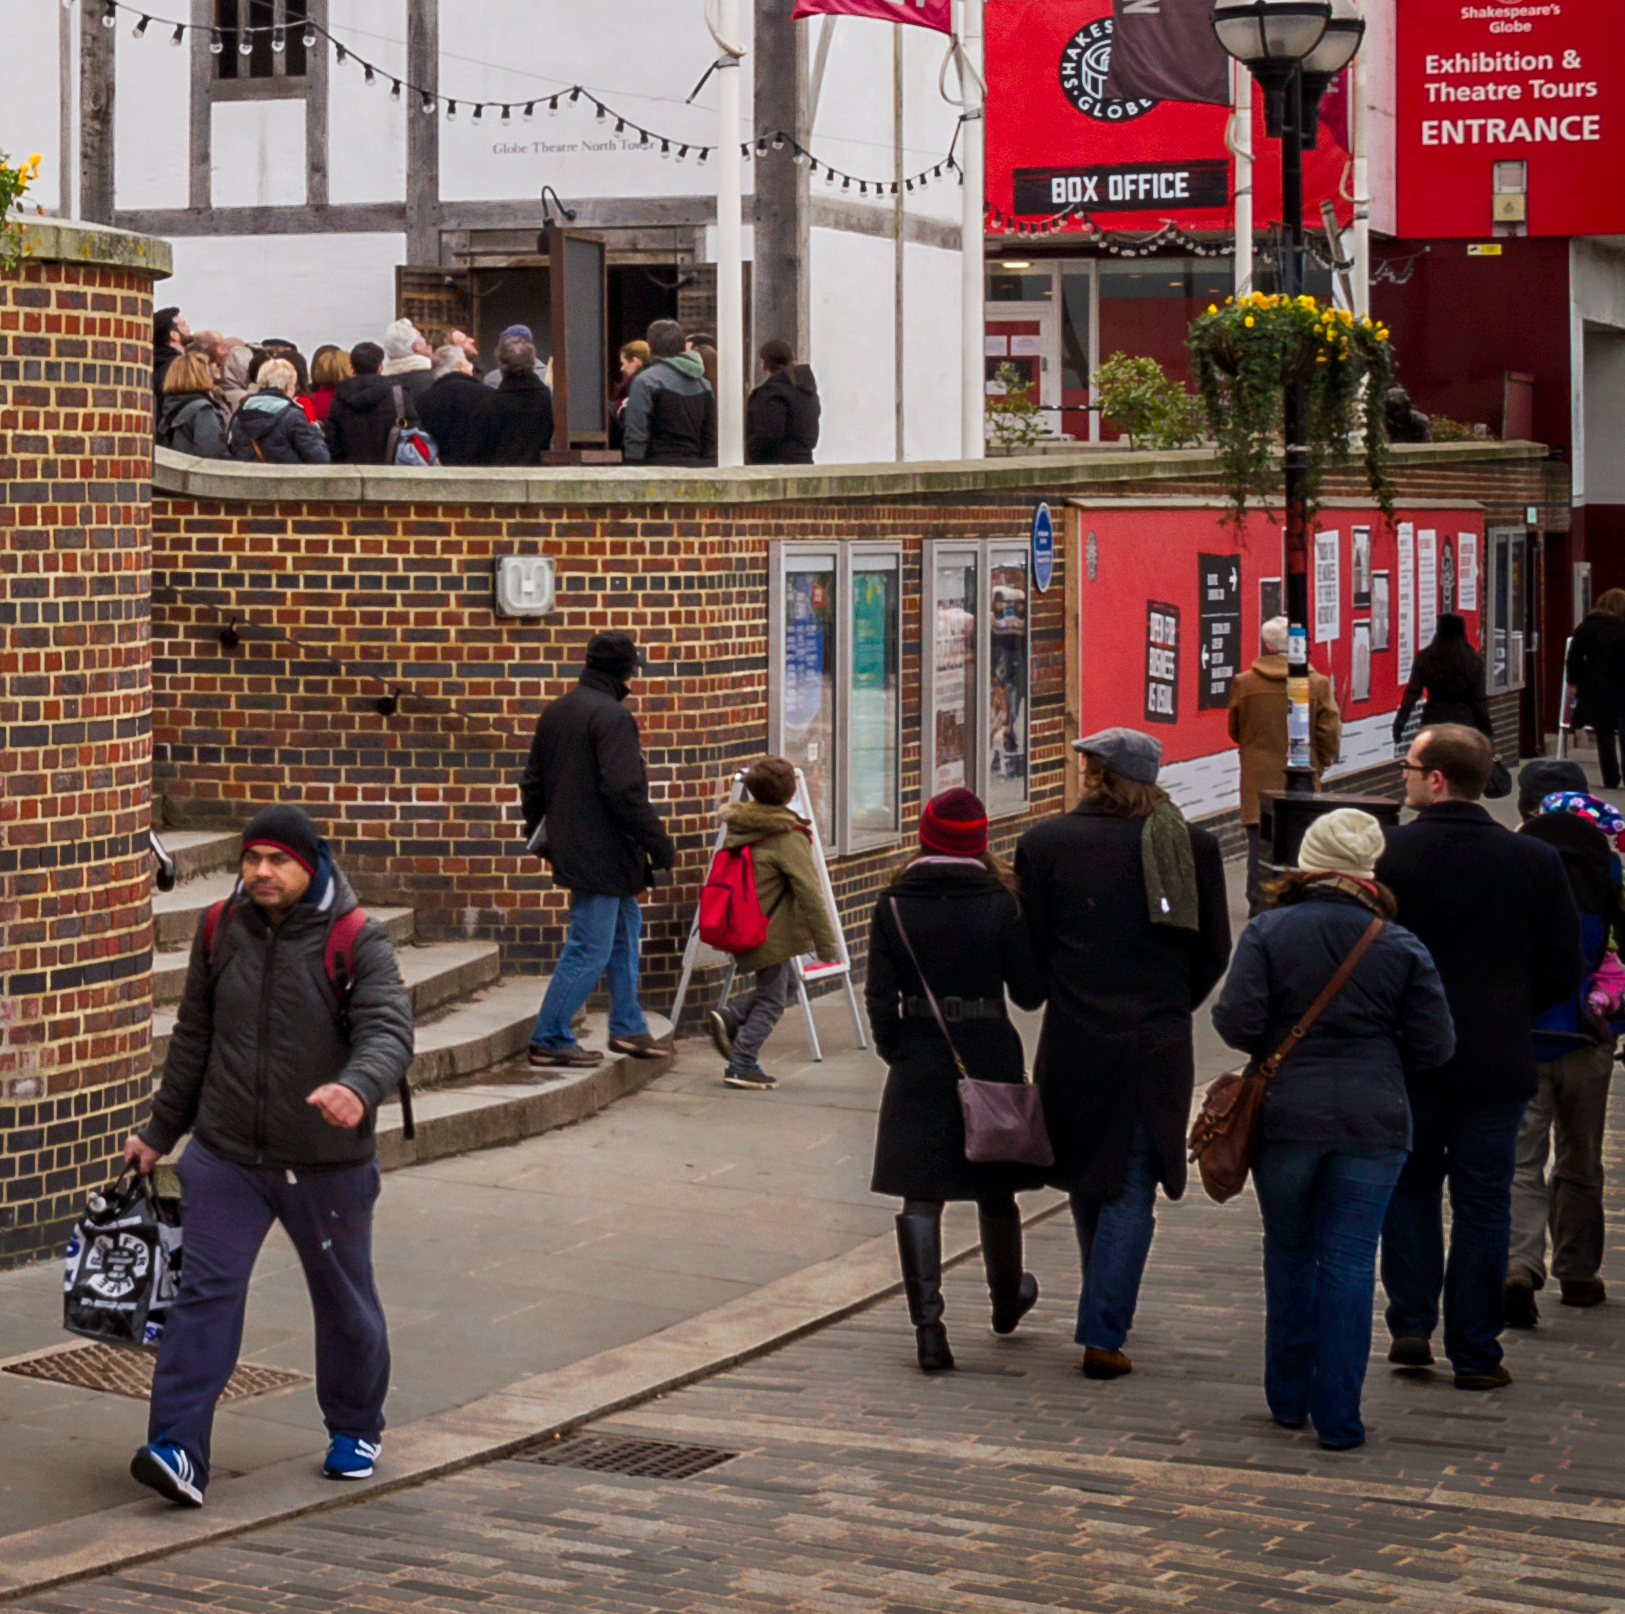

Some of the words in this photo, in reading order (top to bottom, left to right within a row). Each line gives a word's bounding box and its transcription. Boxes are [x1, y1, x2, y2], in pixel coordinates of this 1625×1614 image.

[1460, 3, 1561, 20] Shakespeare's
[1489, 20, 1532, 34] Globe
[1424, 50, 1554, 75] Exhibition
[1561, 48, 1582, 70] &
[1424, 81, 1522, 103] Theatre
[1528, 78, 1598, 99] Tours
[1421, 114, 1601, 146] ENTRANCE
[493, 142, 527, 155] Globe
[532, 141, 578, 154] Theatre
[581, 140, 617, 152] North
[1051, 174, 1098, 205] BOX
[1108, 170, 1191, 200] OFFICE
